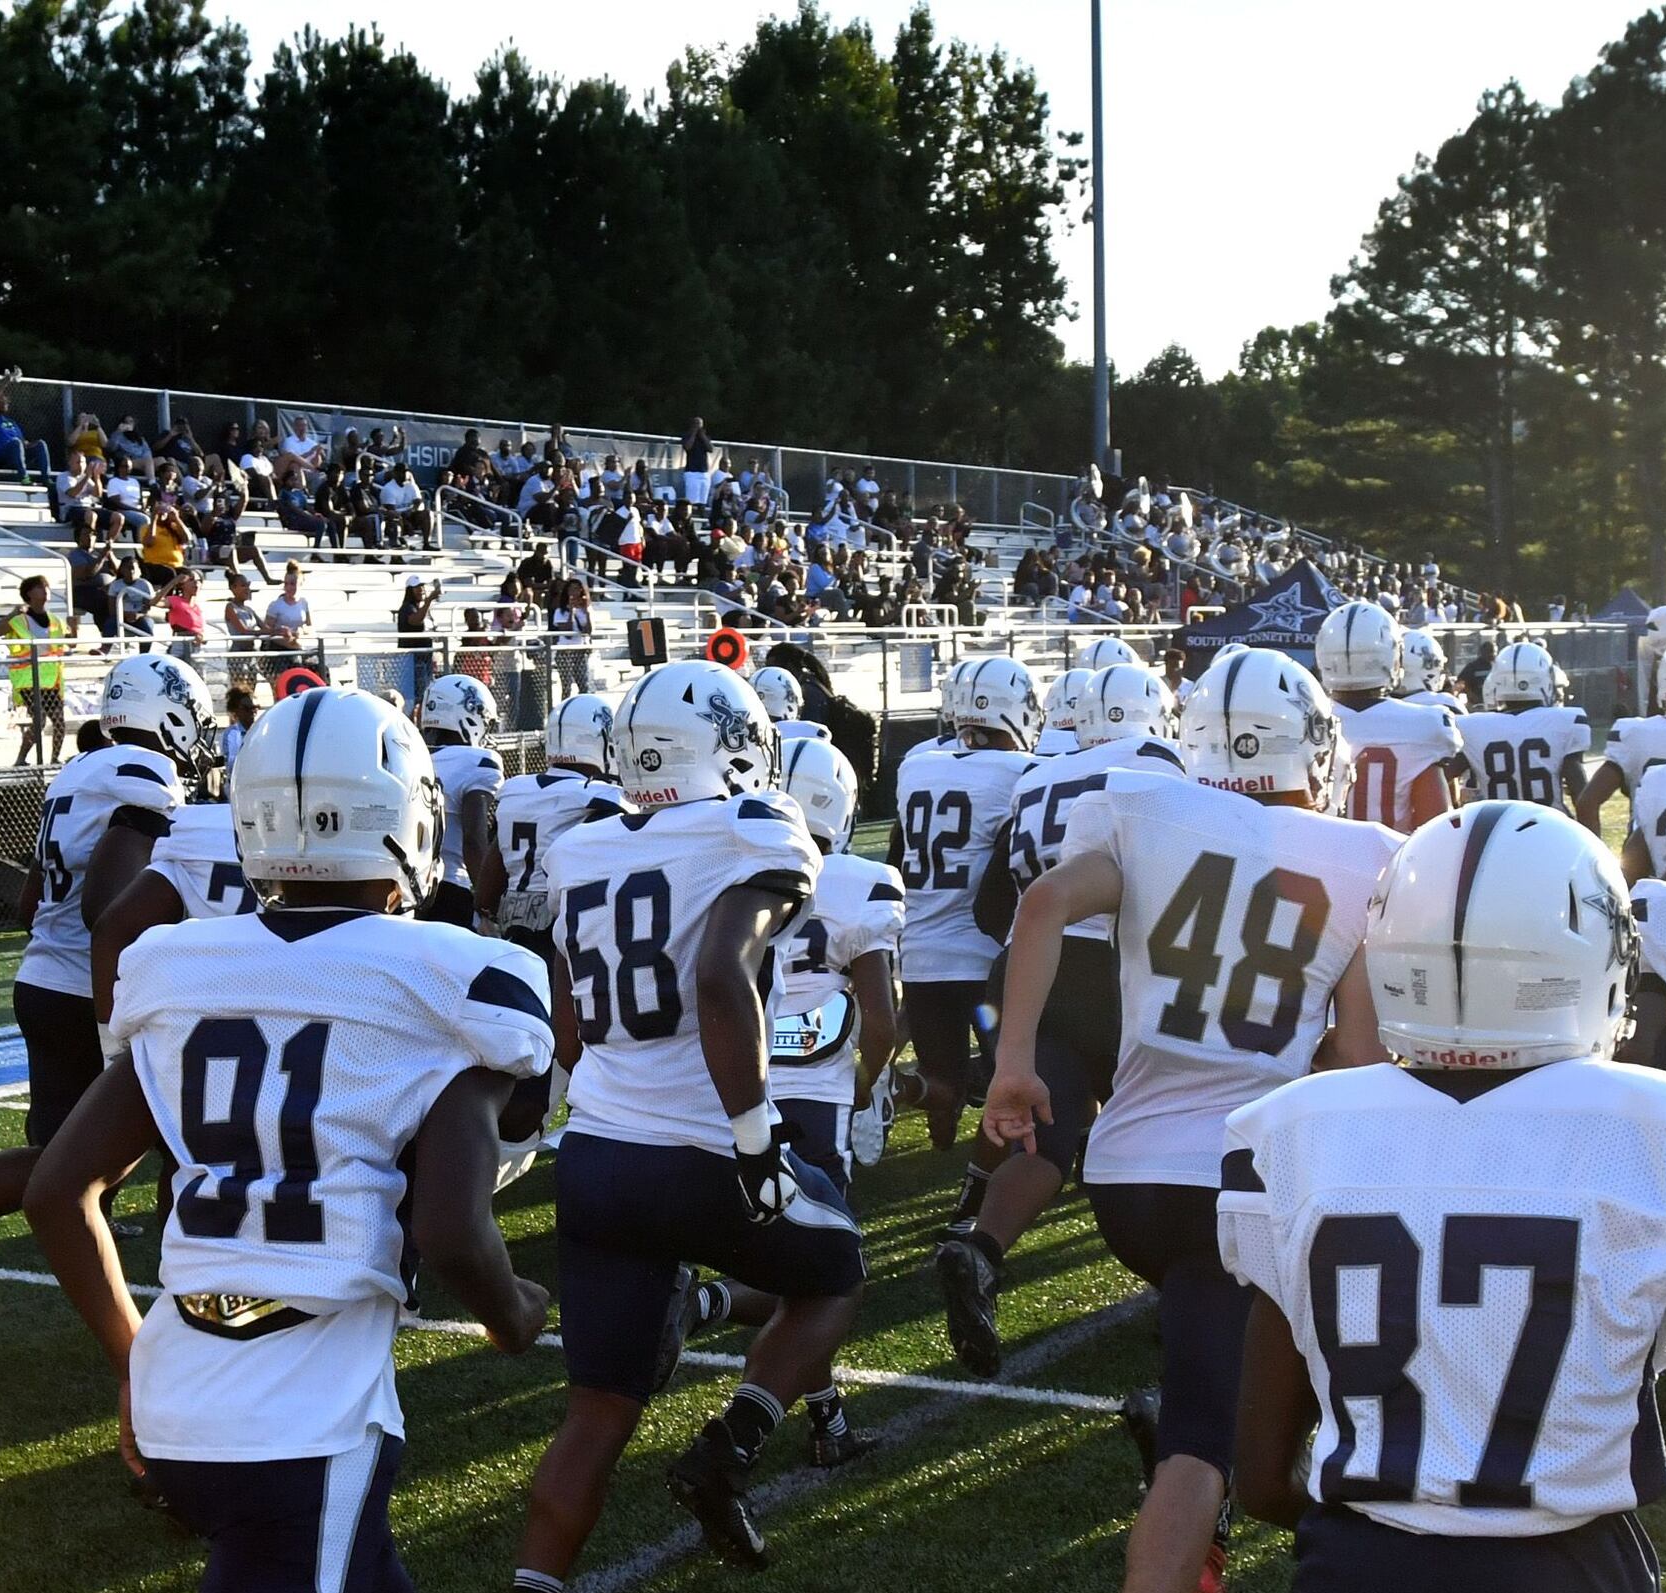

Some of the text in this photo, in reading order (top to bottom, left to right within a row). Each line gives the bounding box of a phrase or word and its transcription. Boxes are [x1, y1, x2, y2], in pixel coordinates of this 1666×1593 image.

[636, 620, 655, 656] 1
[1186, 635, 1227, 646] SOUTH
[1229, 631, 1293, 645] GWINNETT
[708, 694, 748, 753] SG
[1110, 710, 1122, 719] 55
[642, 753, 660, 768] 58
[1237, 738, 1257, 754] 48
[1483, 737, 1553, 805] 86
[315, 811, 339, 832] 91
[904, 790, 973, 890] 92
[565, 869, 683, 1044] 58
[1147, 850, 1332, 1057] 48
[175, 1015, 333, 1245] 91
[1308, 1210, 1582, 1508] 87
